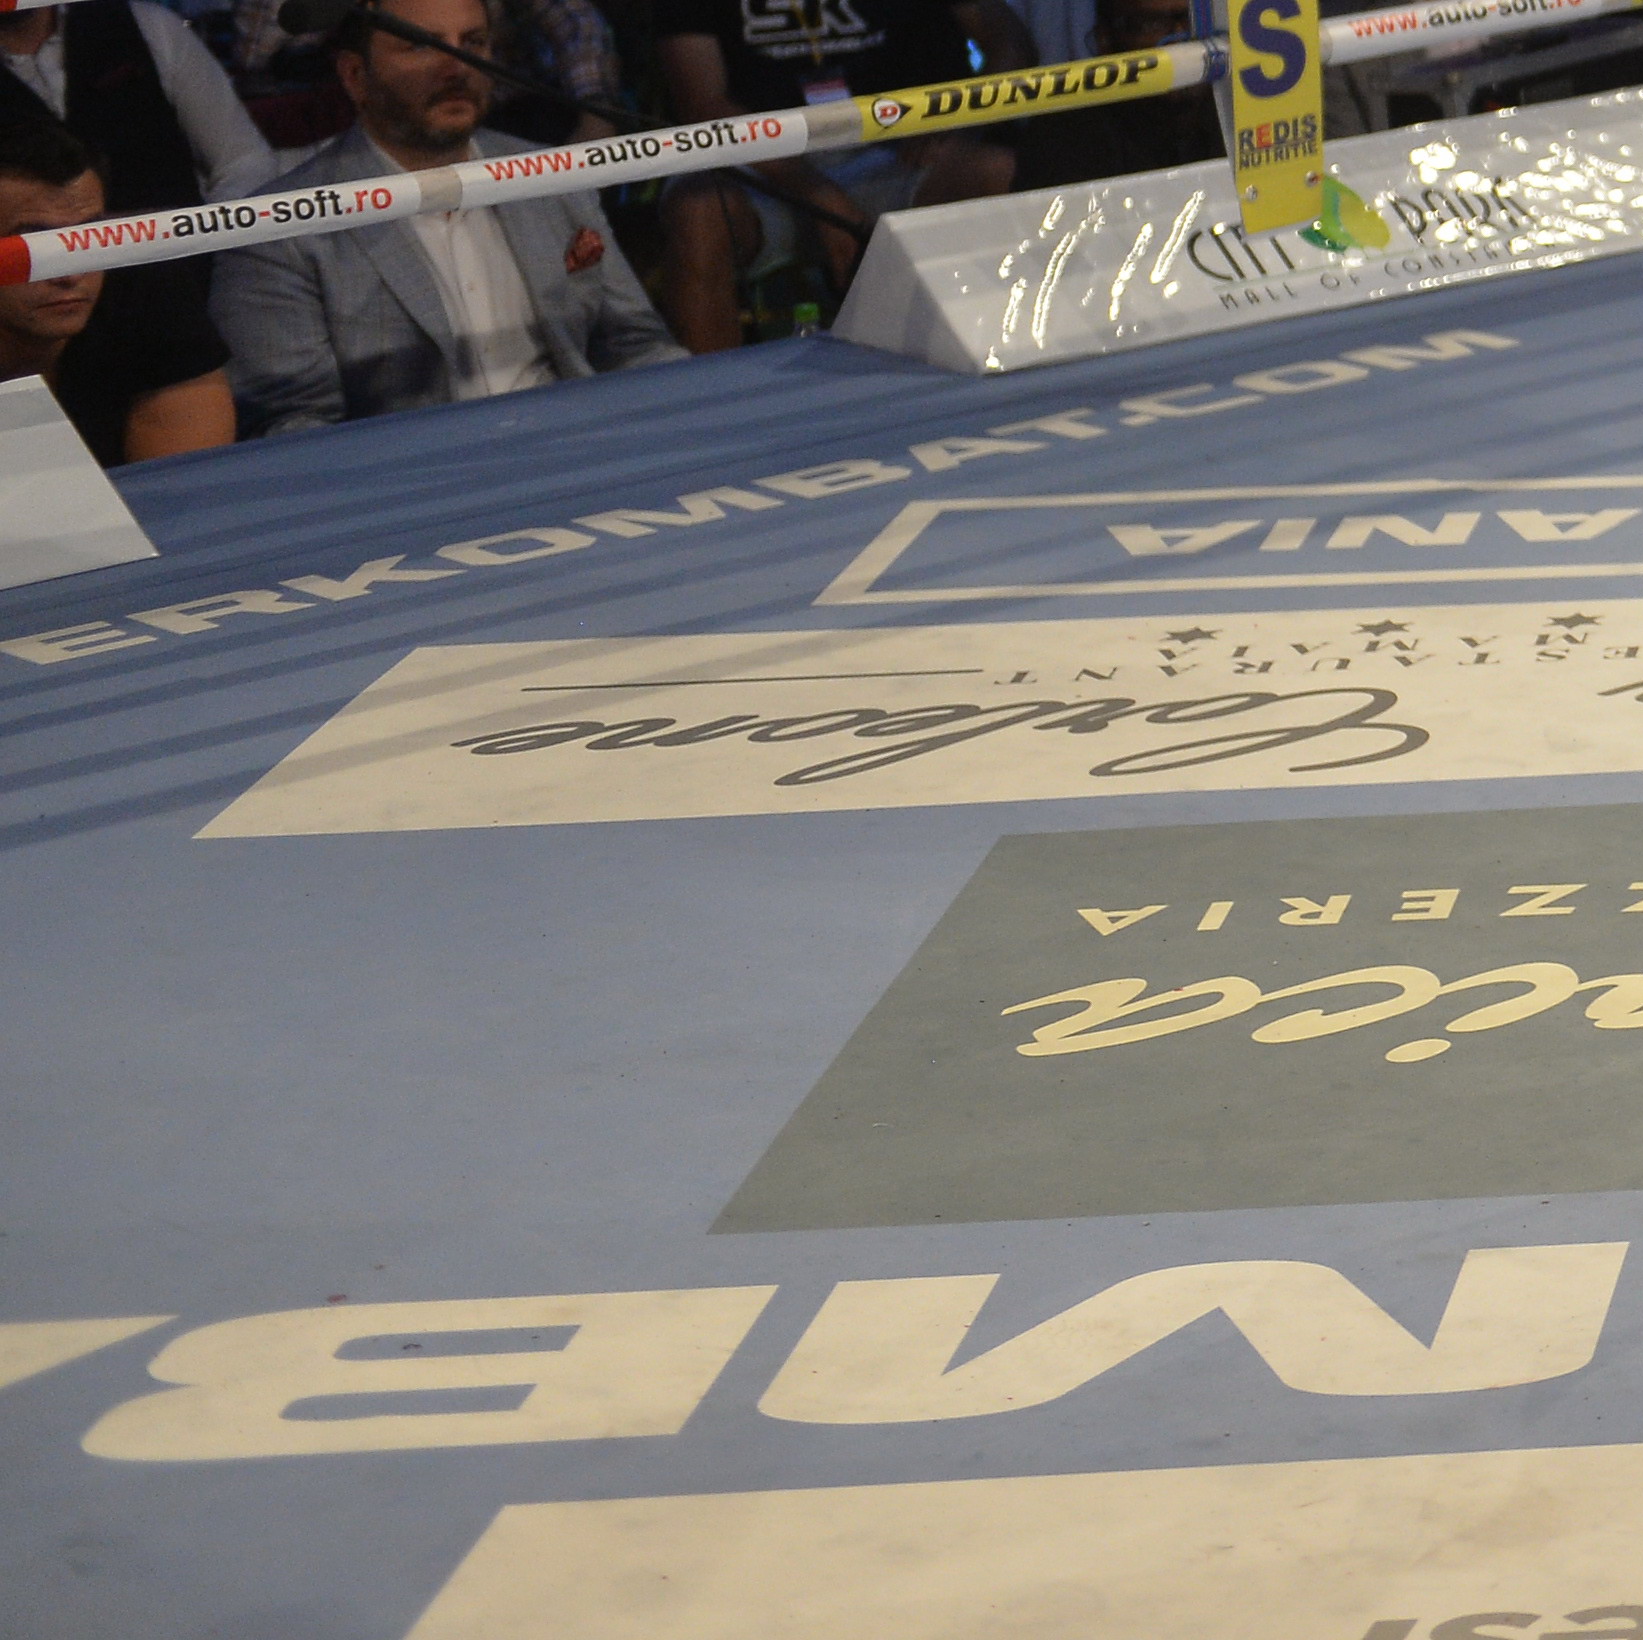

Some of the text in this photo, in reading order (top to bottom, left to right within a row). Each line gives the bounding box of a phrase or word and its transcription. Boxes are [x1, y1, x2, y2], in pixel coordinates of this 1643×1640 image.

[920, 56, 1159, 119] DUNLOP
[485, 115, 783, 183] www.auto-soft.ro
[1238, 113, 1317, 150] REDIS
[57, 183, 393, 253] www.auto-soft.ro
[450, 686, 1431, 787] Corleone
